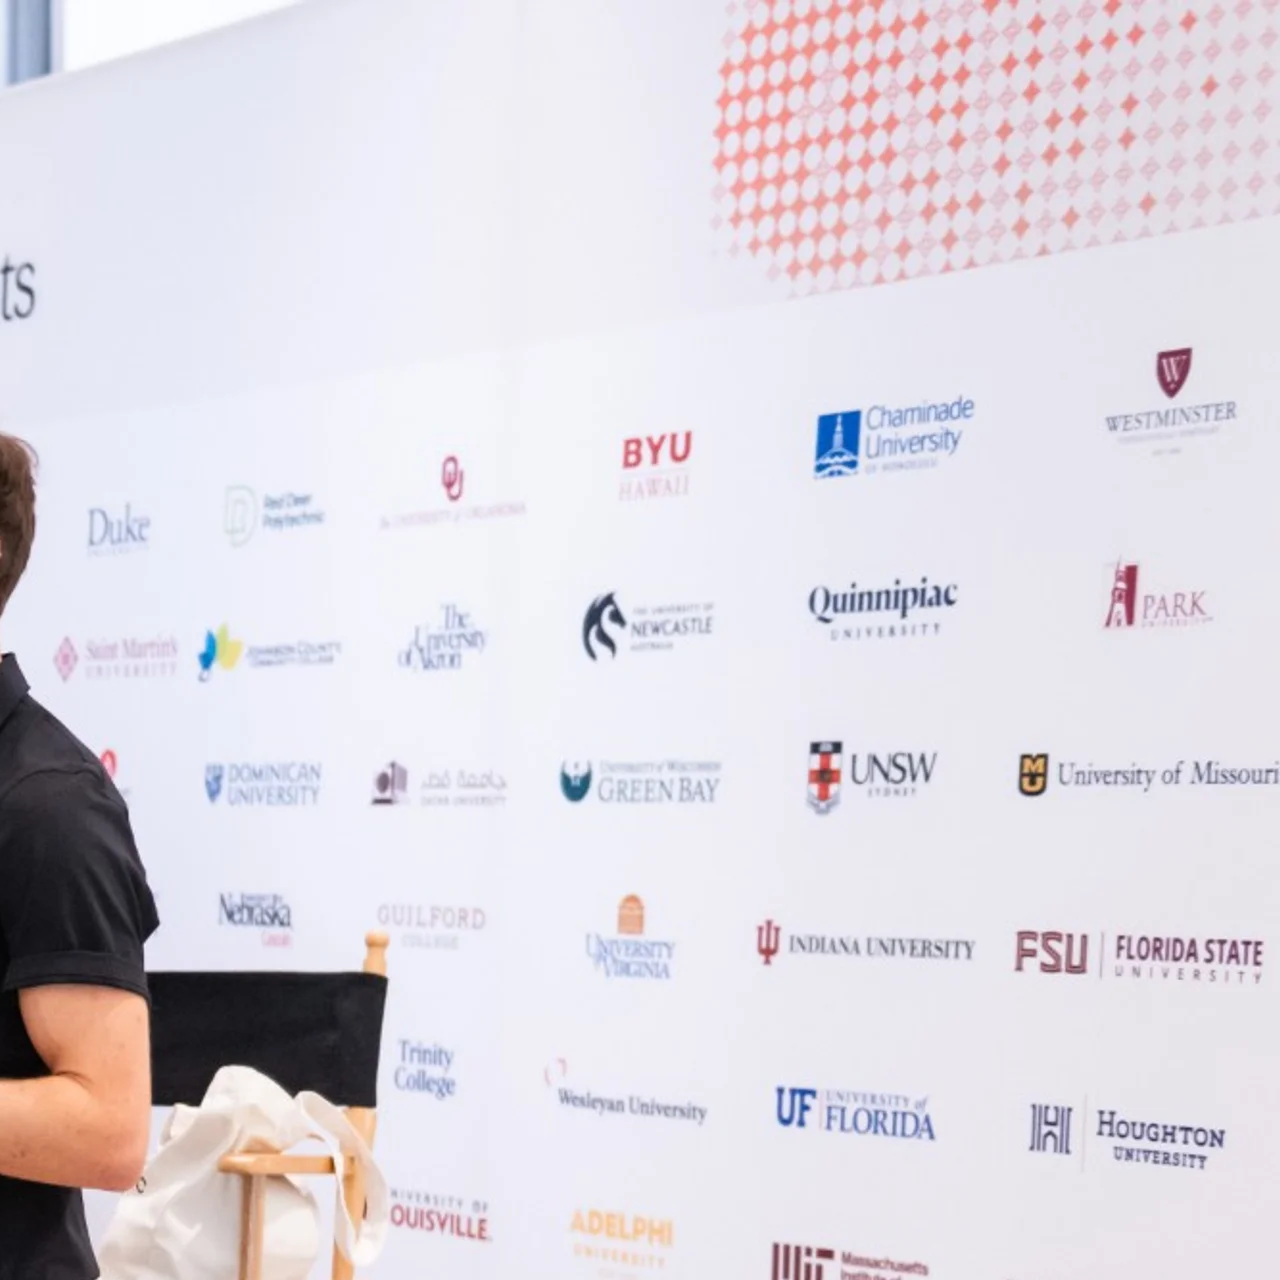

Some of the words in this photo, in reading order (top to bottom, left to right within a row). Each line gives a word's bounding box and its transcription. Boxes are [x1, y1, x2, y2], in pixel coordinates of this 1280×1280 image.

[865, 395, 975, 430] Chaminade
[1105, 401, 1237, 432] WESTMINSTER
[621, 430, 693, 469] BYU
[864, 427, 963, 461] University
[618, 475, 691, 502] HAWAII
[87, 500, 151, 547] Duke
[808, 575, 958, 624] Quinnipiac
[1143, 590, 1207, 620] PARK
[630, 616, 714, 637] NEWCASTLE
[830, 622, 941, 641] UNIVERSITY
[85, 639, 120, 662] Saint
[228, 761, 322, 783] DOMINICAN
[851, 752, 938, 785] UNSW
[1058, 762, 1157, 792] University
[1161, 759, 1184, 785] of
[1190, 759, 1280, 785] Missouri
[227, 783, 320, 806] UNIVERSITY
[597, 776, 675, 803] GREEN
[678, 776, 720, 803] BAY
[218, 892, 292, 929] Nebraska
[376, 902, 487, 930] GUILFORD
[790, 934, 861, 957] INDIANA
[866, 936, 976, 960] UNIVERSITY
[1014, 930, 1089, 975] FSU
[1115, 934, 1199, 964] FLORIDA
[1204, 938, 1264, 967] STATE
[1115, 965, 1263, 985] UNIVERSITY
[398, 1038, 455, 1076] Trinity
[393, 1065, 457, 1102] College
[557, 1087, 626, 1116] Wesleyan
[628, 1095, 708, 1127] University
[776, 1086, 817, 1128] UF
[826, 1089, 910, 1109] UNIVERSITY
[825, 1105, 936, 1141] FLORIDA
[1096, 1109, 1226, 1148] HOUGHTON
[1113, 1145, 1208, 1171] UNIVERSITY
[472, 1200, 488, 1213] OF
[569, 1207, 674, 1249] ADELPHI
[841, 1250, 929, 1276] Massachusetts
